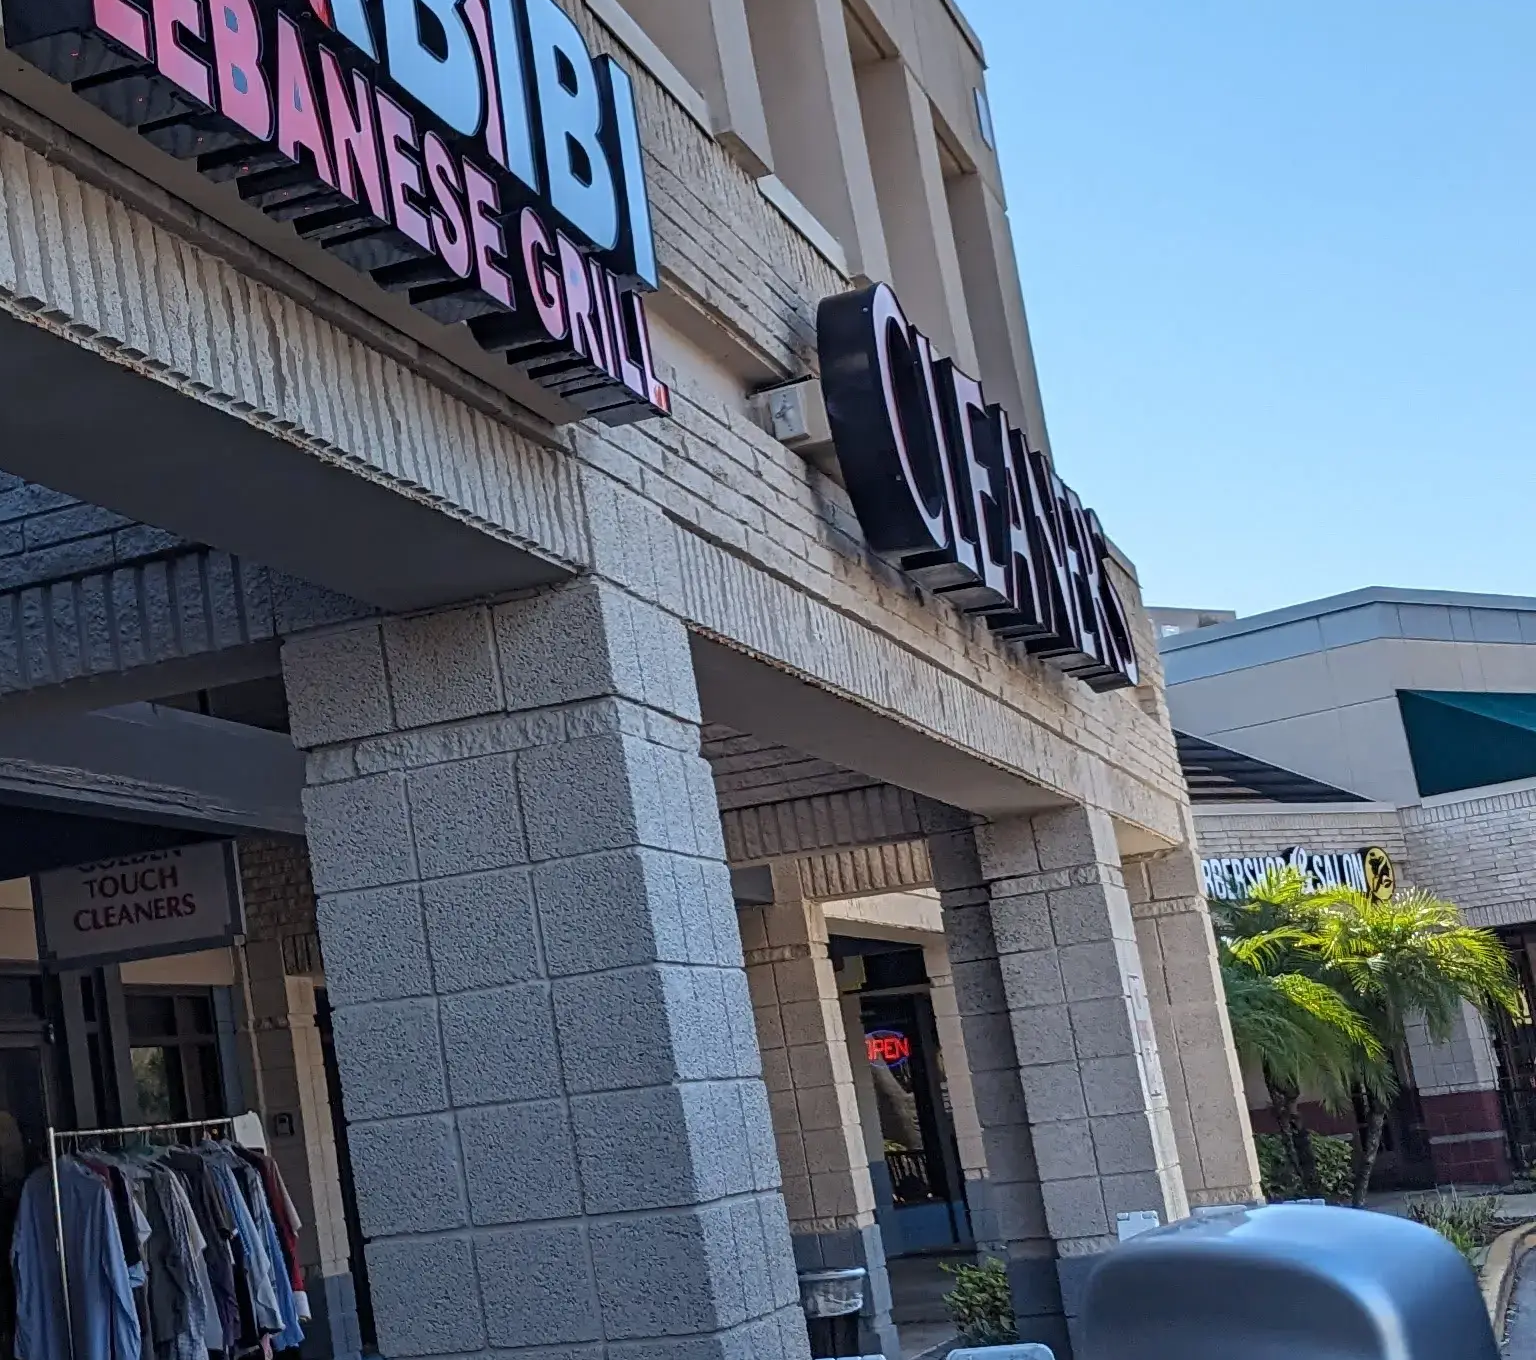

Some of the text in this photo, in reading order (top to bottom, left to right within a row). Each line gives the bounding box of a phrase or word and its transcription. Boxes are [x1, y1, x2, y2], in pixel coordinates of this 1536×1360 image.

[518, 206, 672, 417] GRILL
[82, 864, 180, 899] TOUCH
[1313, 852, 1368, 893] SALON
[72, 892, 197, 932] CLEANERS
